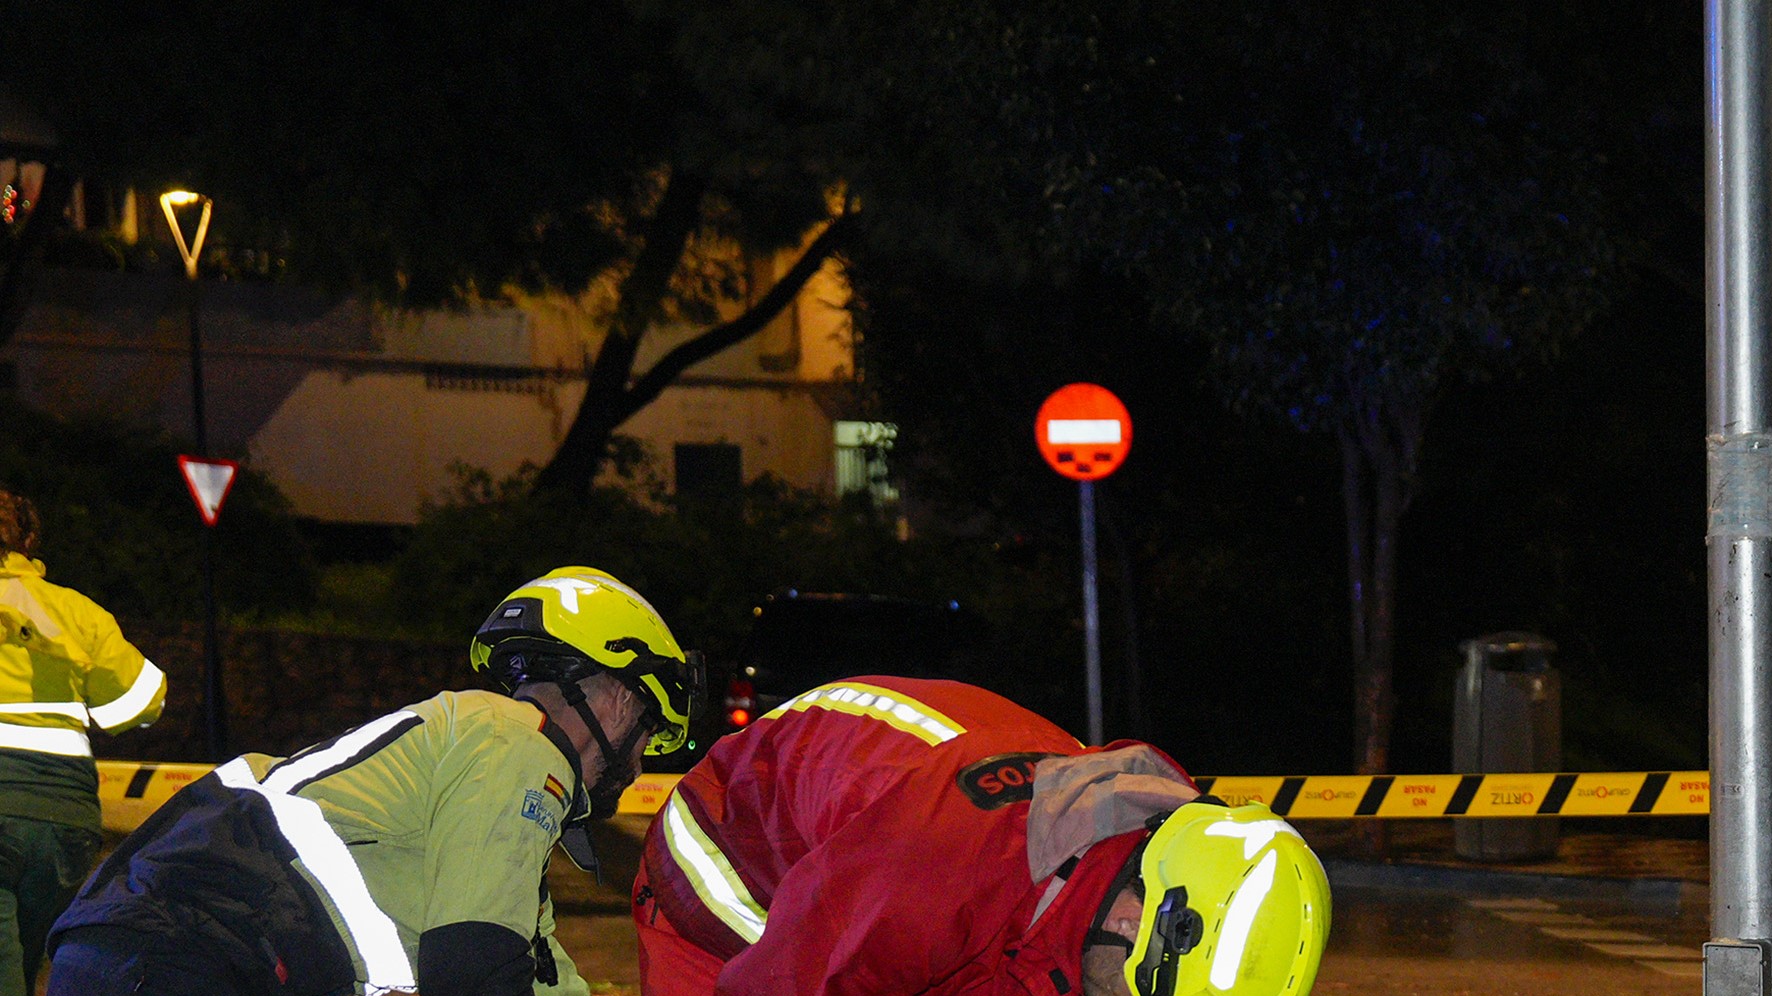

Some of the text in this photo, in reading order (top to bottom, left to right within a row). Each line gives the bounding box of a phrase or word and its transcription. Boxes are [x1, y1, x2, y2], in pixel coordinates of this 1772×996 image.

[1403, 785, 1436, 795] PASAR
[1412, 798, 1428, 807] NO
[1490, 792, 1535, 805] ORTIZ
[1689, 794, 1705, 804] NO
